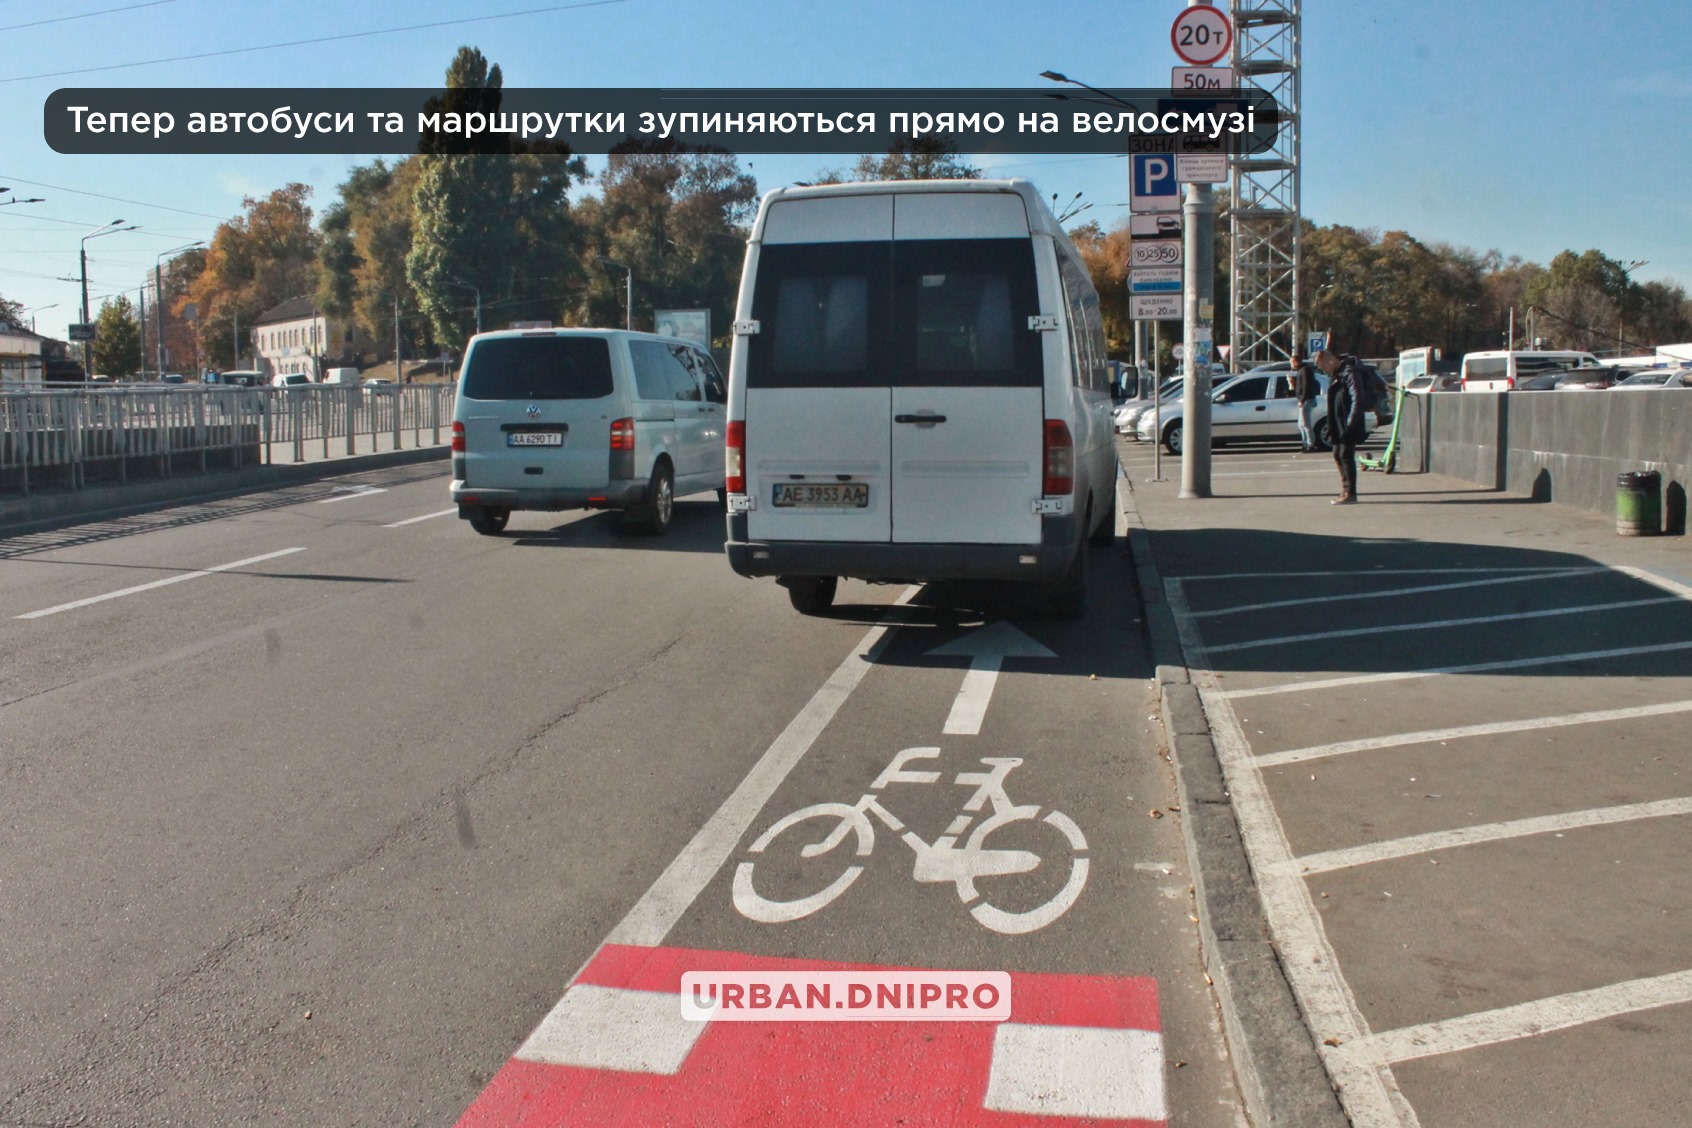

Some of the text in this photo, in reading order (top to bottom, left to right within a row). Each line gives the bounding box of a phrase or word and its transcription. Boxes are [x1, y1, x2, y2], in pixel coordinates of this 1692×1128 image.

[1145, 158, 1168, 194] P
[1136, 247, 1176, 258] 10 25 50
[514, 434, 525, 444] AA
[526, 434, 545, 444] 6290
[783, 487, 863, 502] AE 3953 AA
